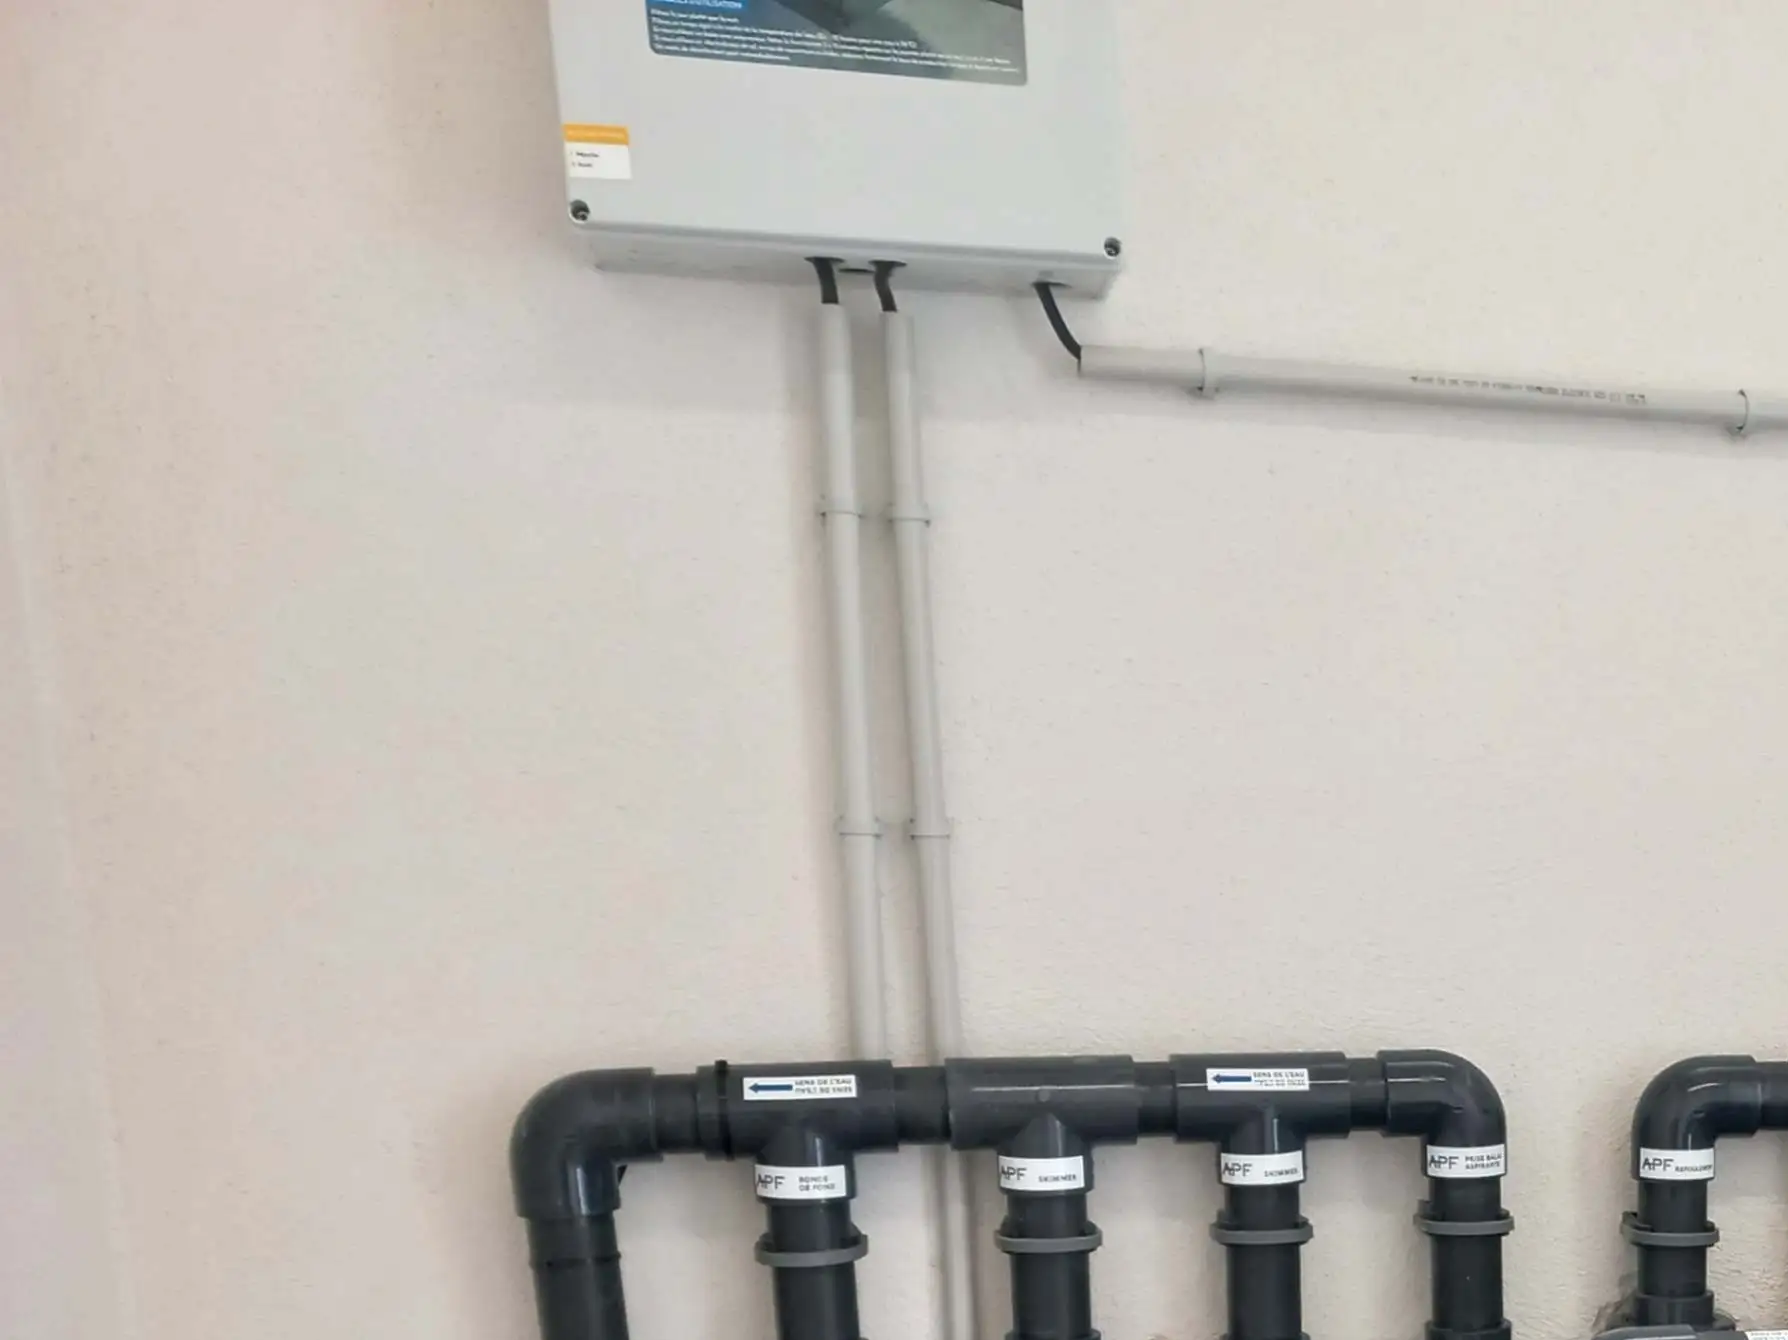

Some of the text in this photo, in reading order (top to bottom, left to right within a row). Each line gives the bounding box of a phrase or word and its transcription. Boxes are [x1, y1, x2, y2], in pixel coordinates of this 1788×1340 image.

[1223, 1162, 1253, 1177] APF
[1429, 1154, 1459, 1170] APF
[1642, 1157, 1675, 1171] APF
[1001, 1166, 1027, 1180] APF
[757, 1174, 785, 1190] APF
